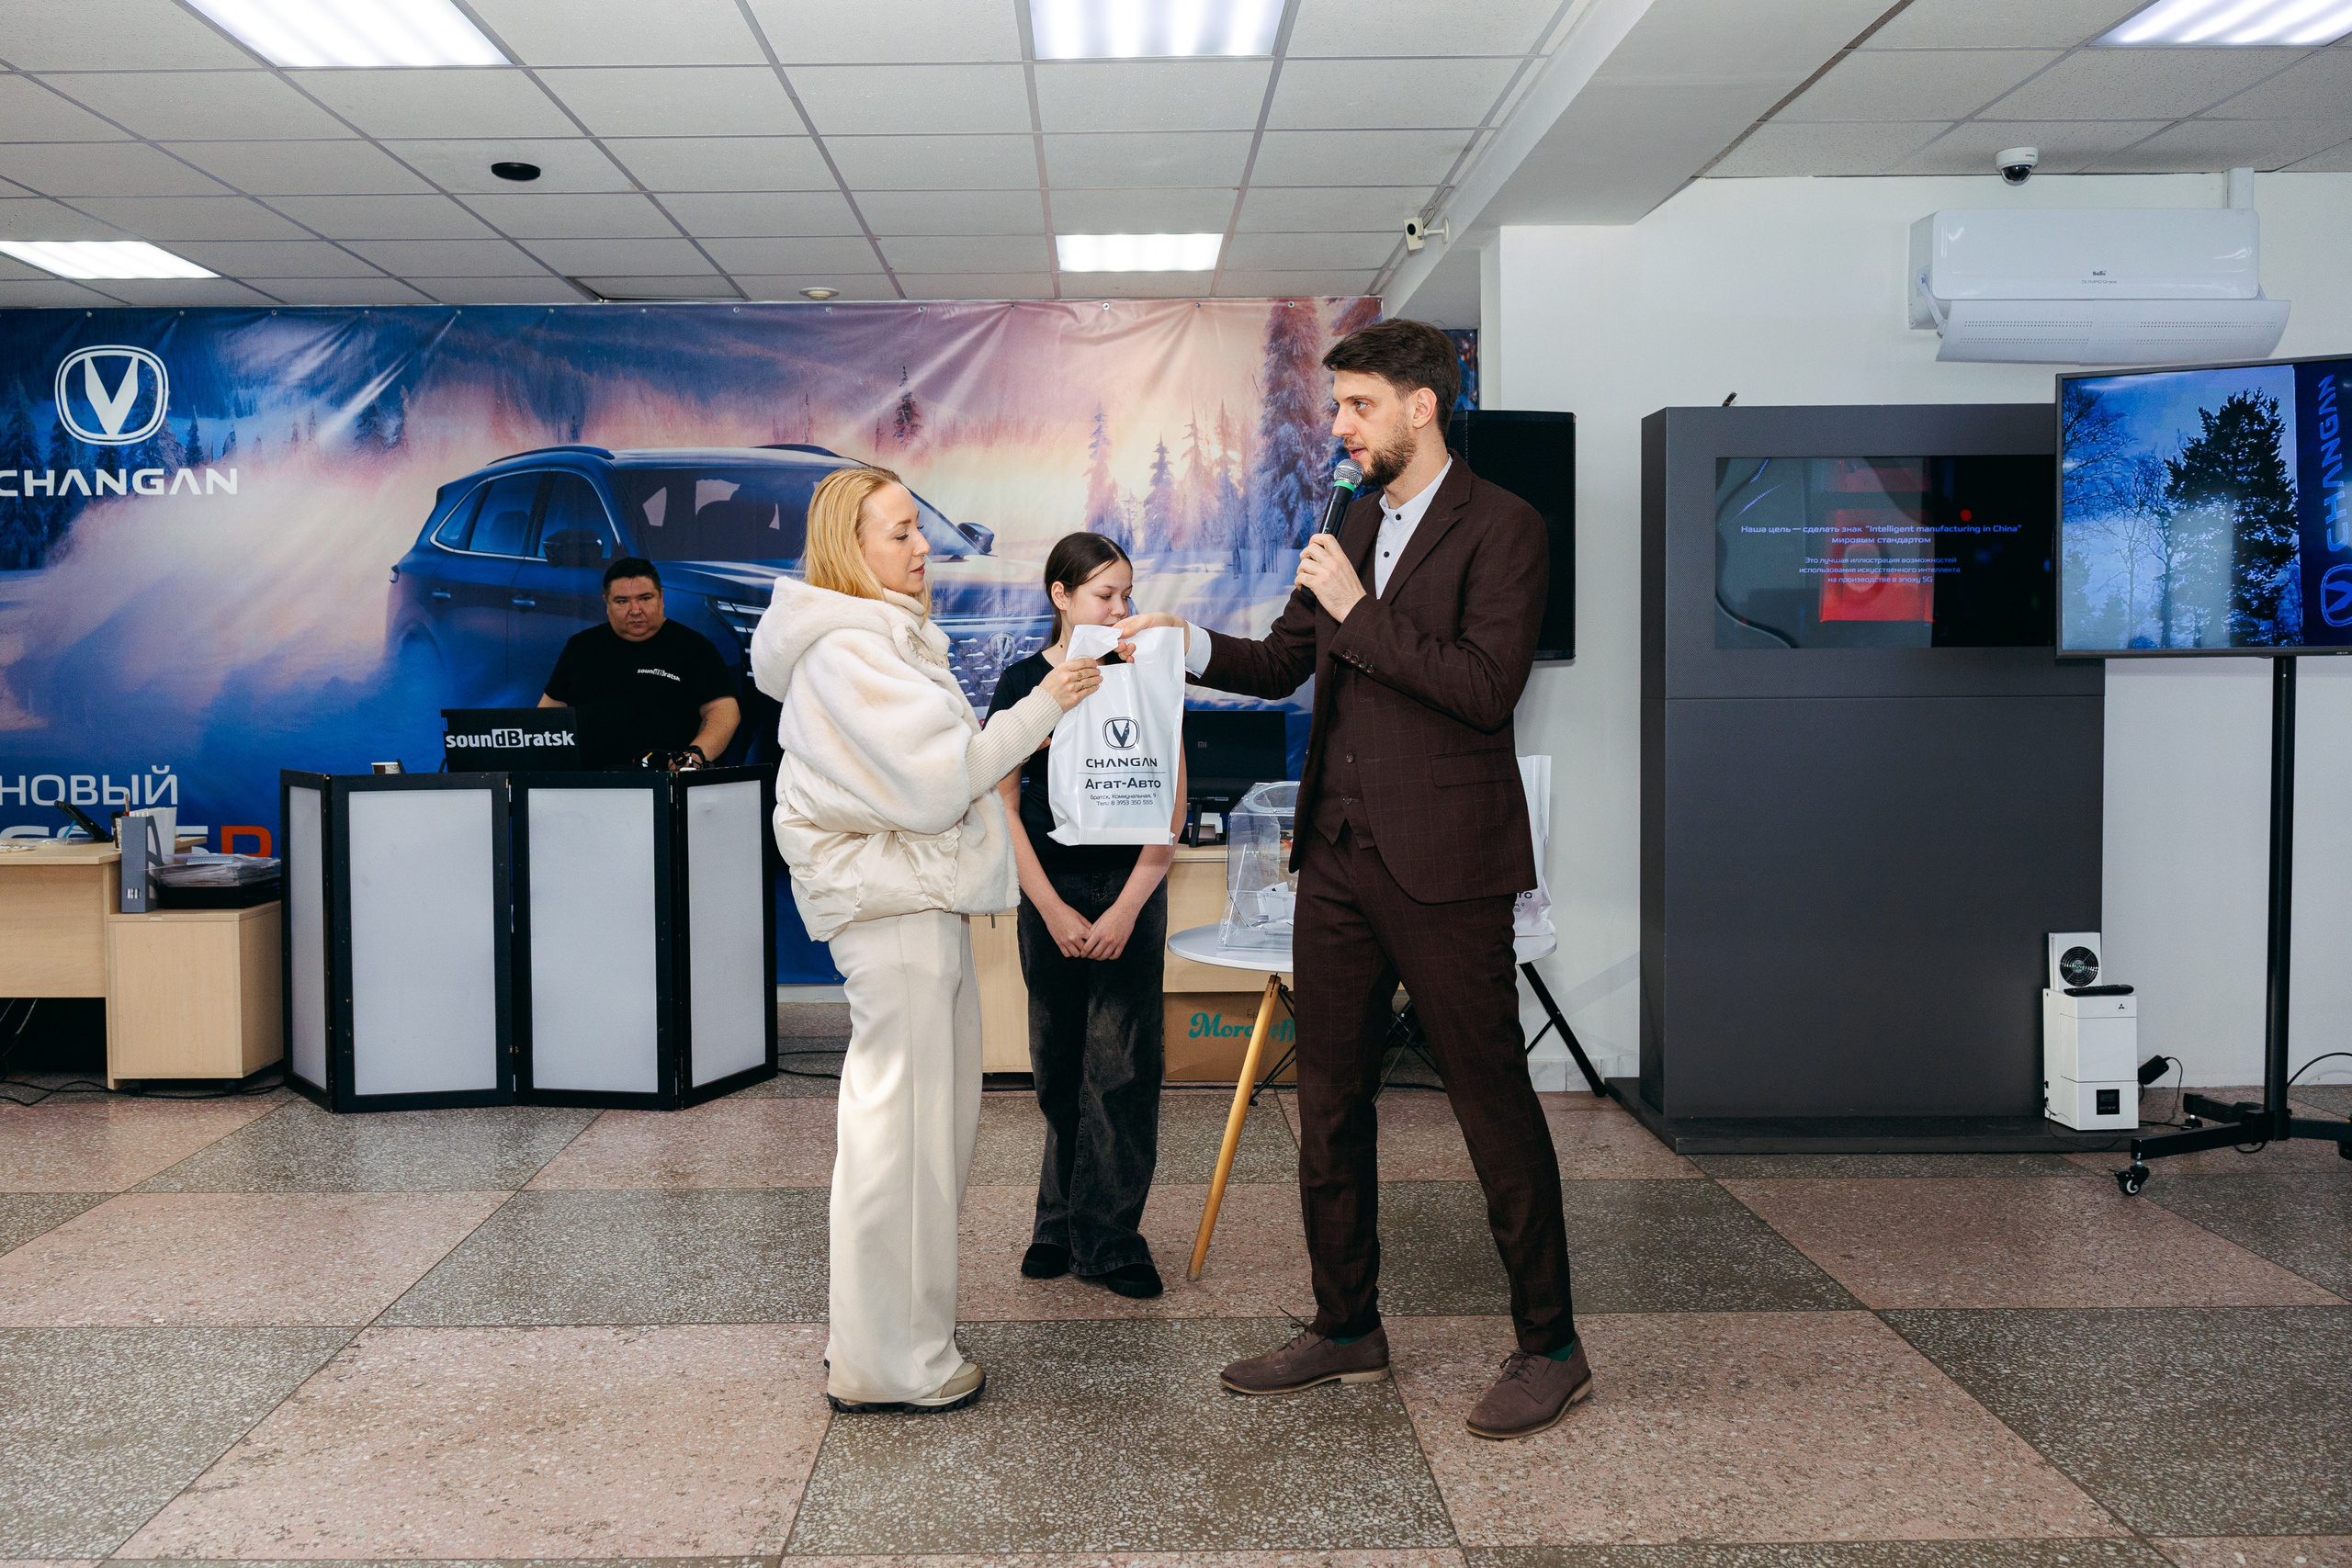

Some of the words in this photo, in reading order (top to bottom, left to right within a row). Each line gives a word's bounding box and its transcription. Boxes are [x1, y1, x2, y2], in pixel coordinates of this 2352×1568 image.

[2318, 374, 2349, 553] CHANGAN
[0, 468, 238, 497] CHANGAN
[1917, 525, 1981, 534] manufacturing
[1983, 525, 1991, 533] in
[445, 728, 575, 749] soundBratsk
[1085, 757, 1158, 768] CHANGAN
[0, 764, 178, 807] НОВЫЙ
[1085, 777, 1161, 790] Агат-Авто
